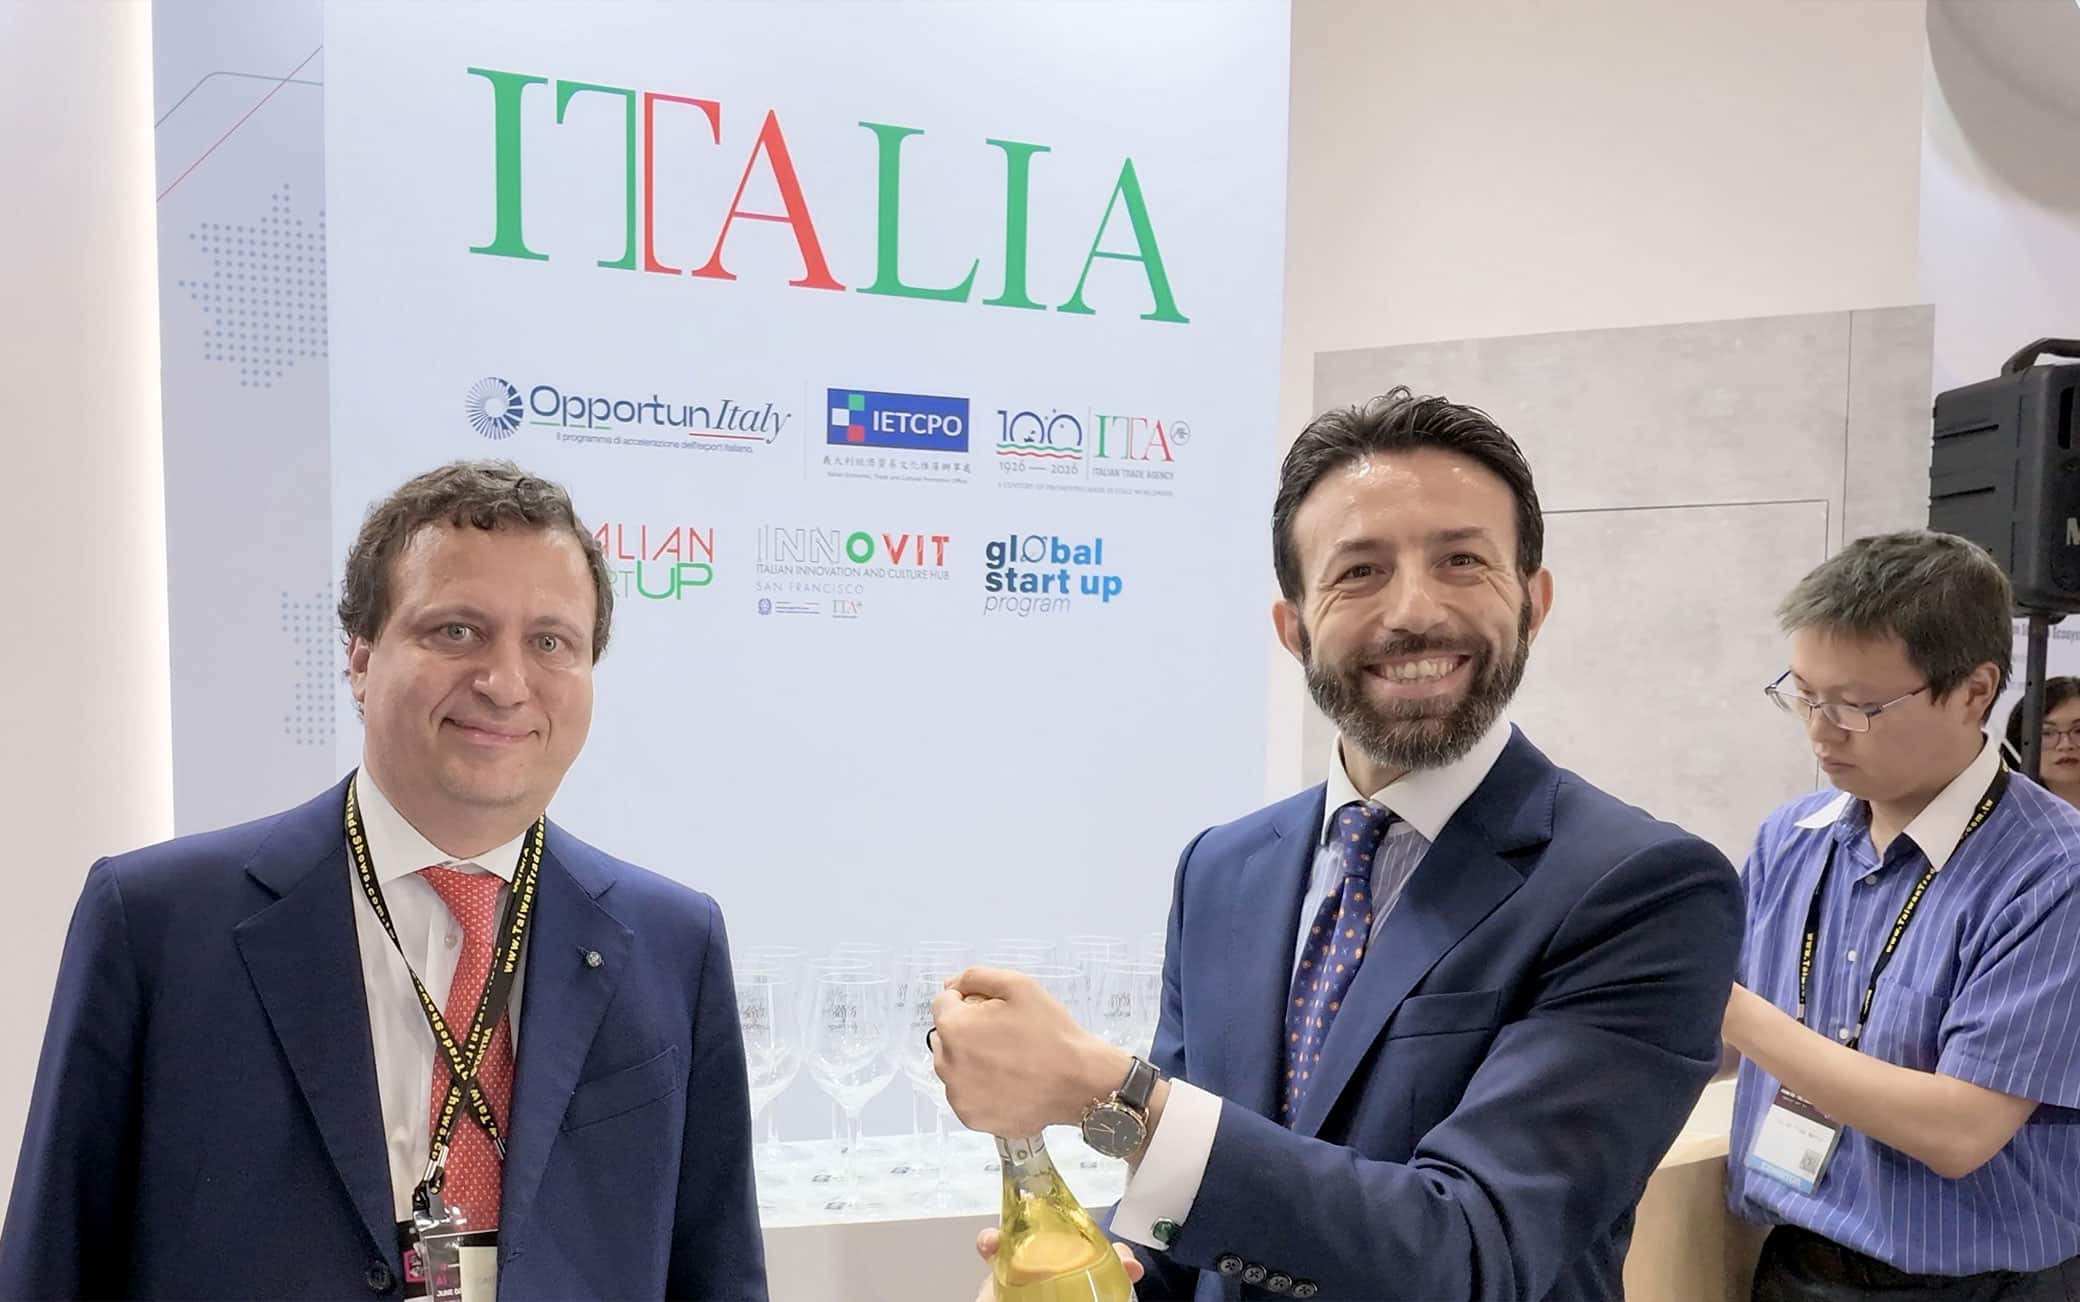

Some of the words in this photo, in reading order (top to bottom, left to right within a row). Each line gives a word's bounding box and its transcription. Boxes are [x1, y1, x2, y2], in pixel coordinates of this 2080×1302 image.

[467, 67, 1190, 324] ITALIA
[529, 384, 792, 444] OpportunItaly
[873, 410, 963, 437] IETCPO
[997, 410, 1083, 447] 100
[1094, 414, 1176, 463] ITA
[999, 460, 1026, 475] 1926
[1051, 462, 1079, 475] 2026
[757, 525, 950, 567] INNOVIT
[985, 534, 1103, 570] global
[756, 564, 793, 576] ITALIAN
[795, 565, 861, 577] INNOVATION
[863, 567, 885, 578] AND
[887, 568, 928, 580] CULTURE
[930, 569, 950, 581] HUB
[756, 581, 783, 592] SAN
[789, 582, 864, 595] FRANCISCO
[985, 567, 1071, 595] start
[1080, 574, 1123, 603] up
[983, 595, 1071, 618] program
